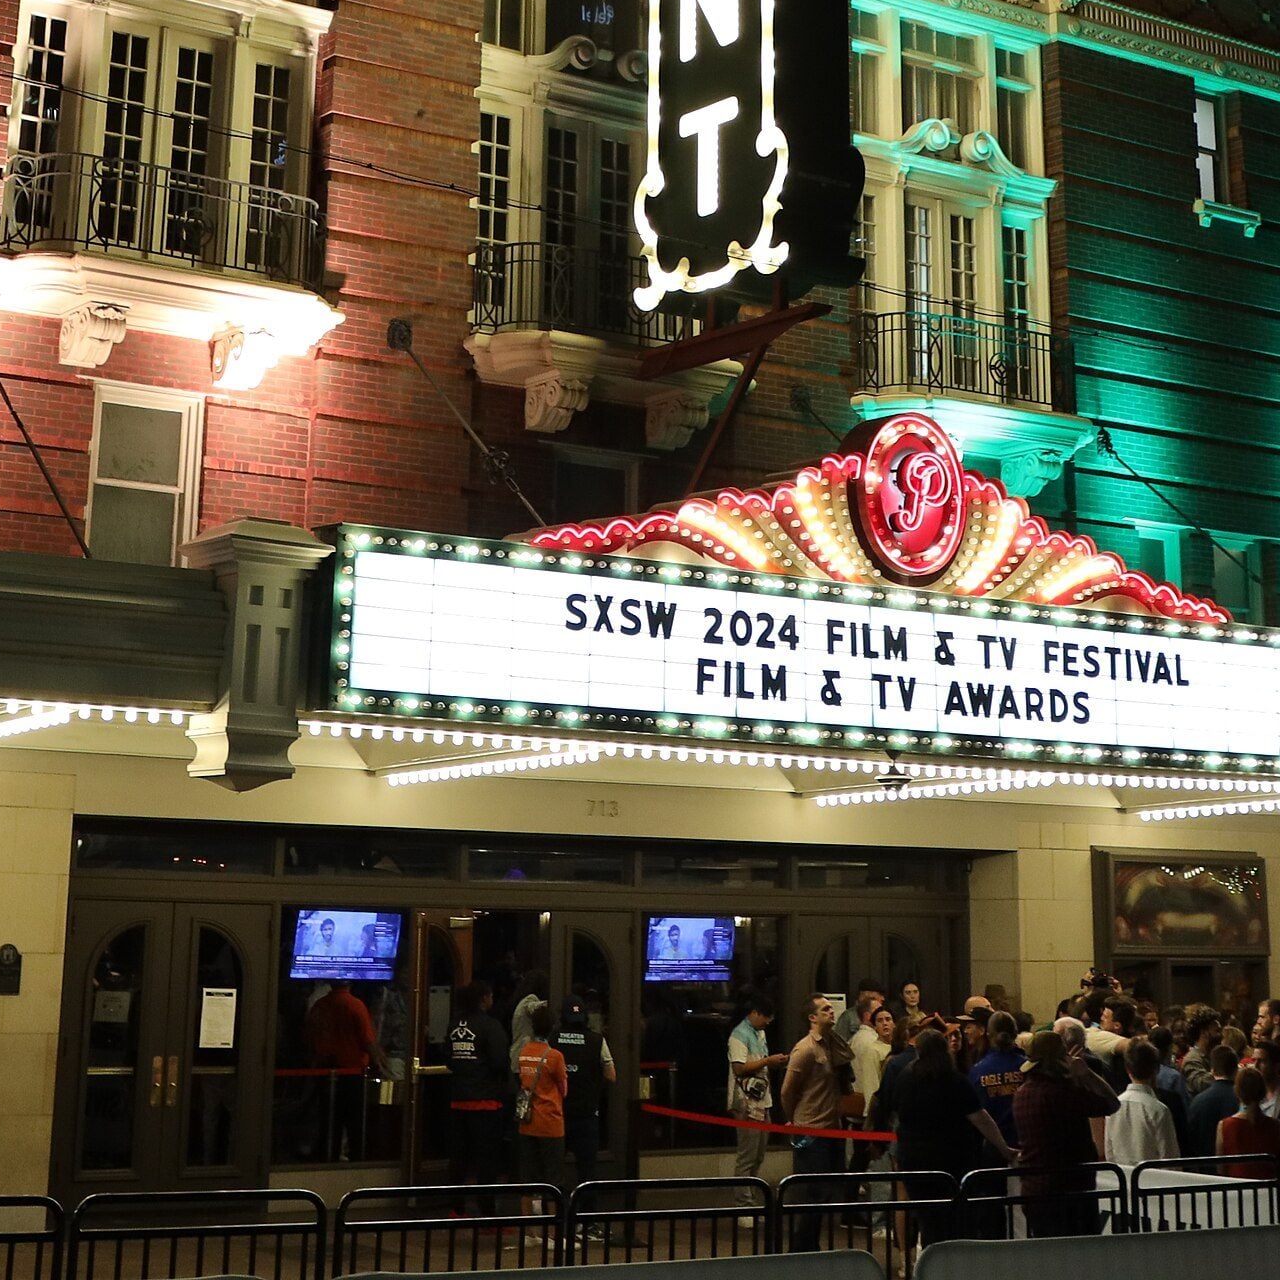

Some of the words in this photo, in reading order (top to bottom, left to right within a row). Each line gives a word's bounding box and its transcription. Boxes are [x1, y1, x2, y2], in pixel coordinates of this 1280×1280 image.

[565, 593, 677, 640] SXSW
[703, 607, 800, 651] 2024
[826, 620, 908, 662] FILM
[934, 630, 956, 666] &
[977, 634, 1017, 671] TV
[1043, 639, 1191, 687] FESTIVAL
[696, 657, 787, 702] FILM
[820, 669, 842, 707] &
[870, 674, 916, 712] TV
[944, 680, 1090, 725] AWARDS
[586, 798, 619, 818] 713
